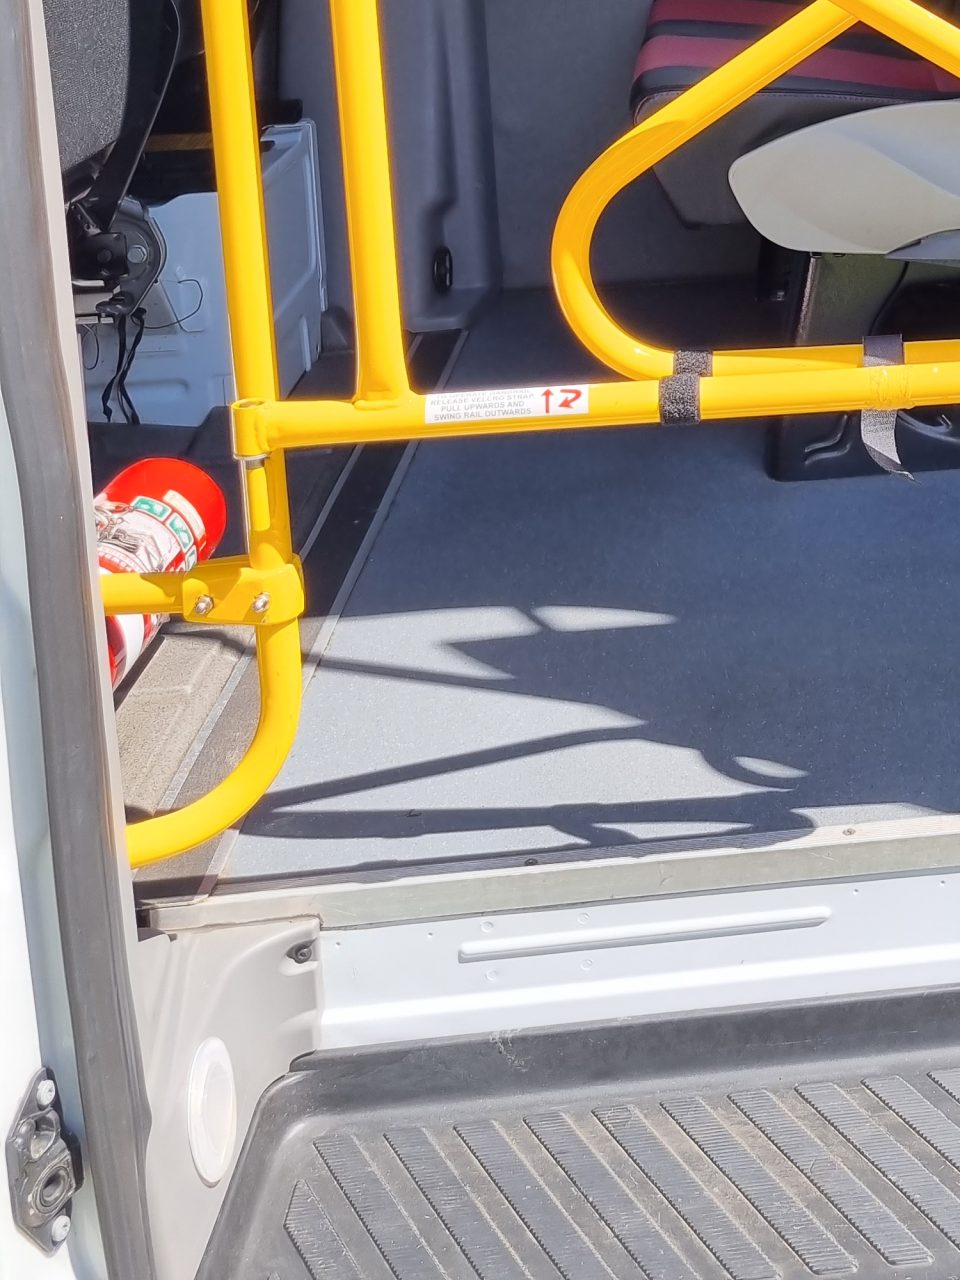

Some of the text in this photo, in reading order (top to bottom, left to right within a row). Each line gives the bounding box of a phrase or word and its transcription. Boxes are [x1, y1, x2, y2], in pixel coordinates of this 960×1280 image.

[471, 395, 505, 403] VELCRO
[464, 402, 505, 411] UPWARDS
[507, 400, 525, 408] AND
[434, 407, 532, 421] SWING RAIL OUTWARDS
